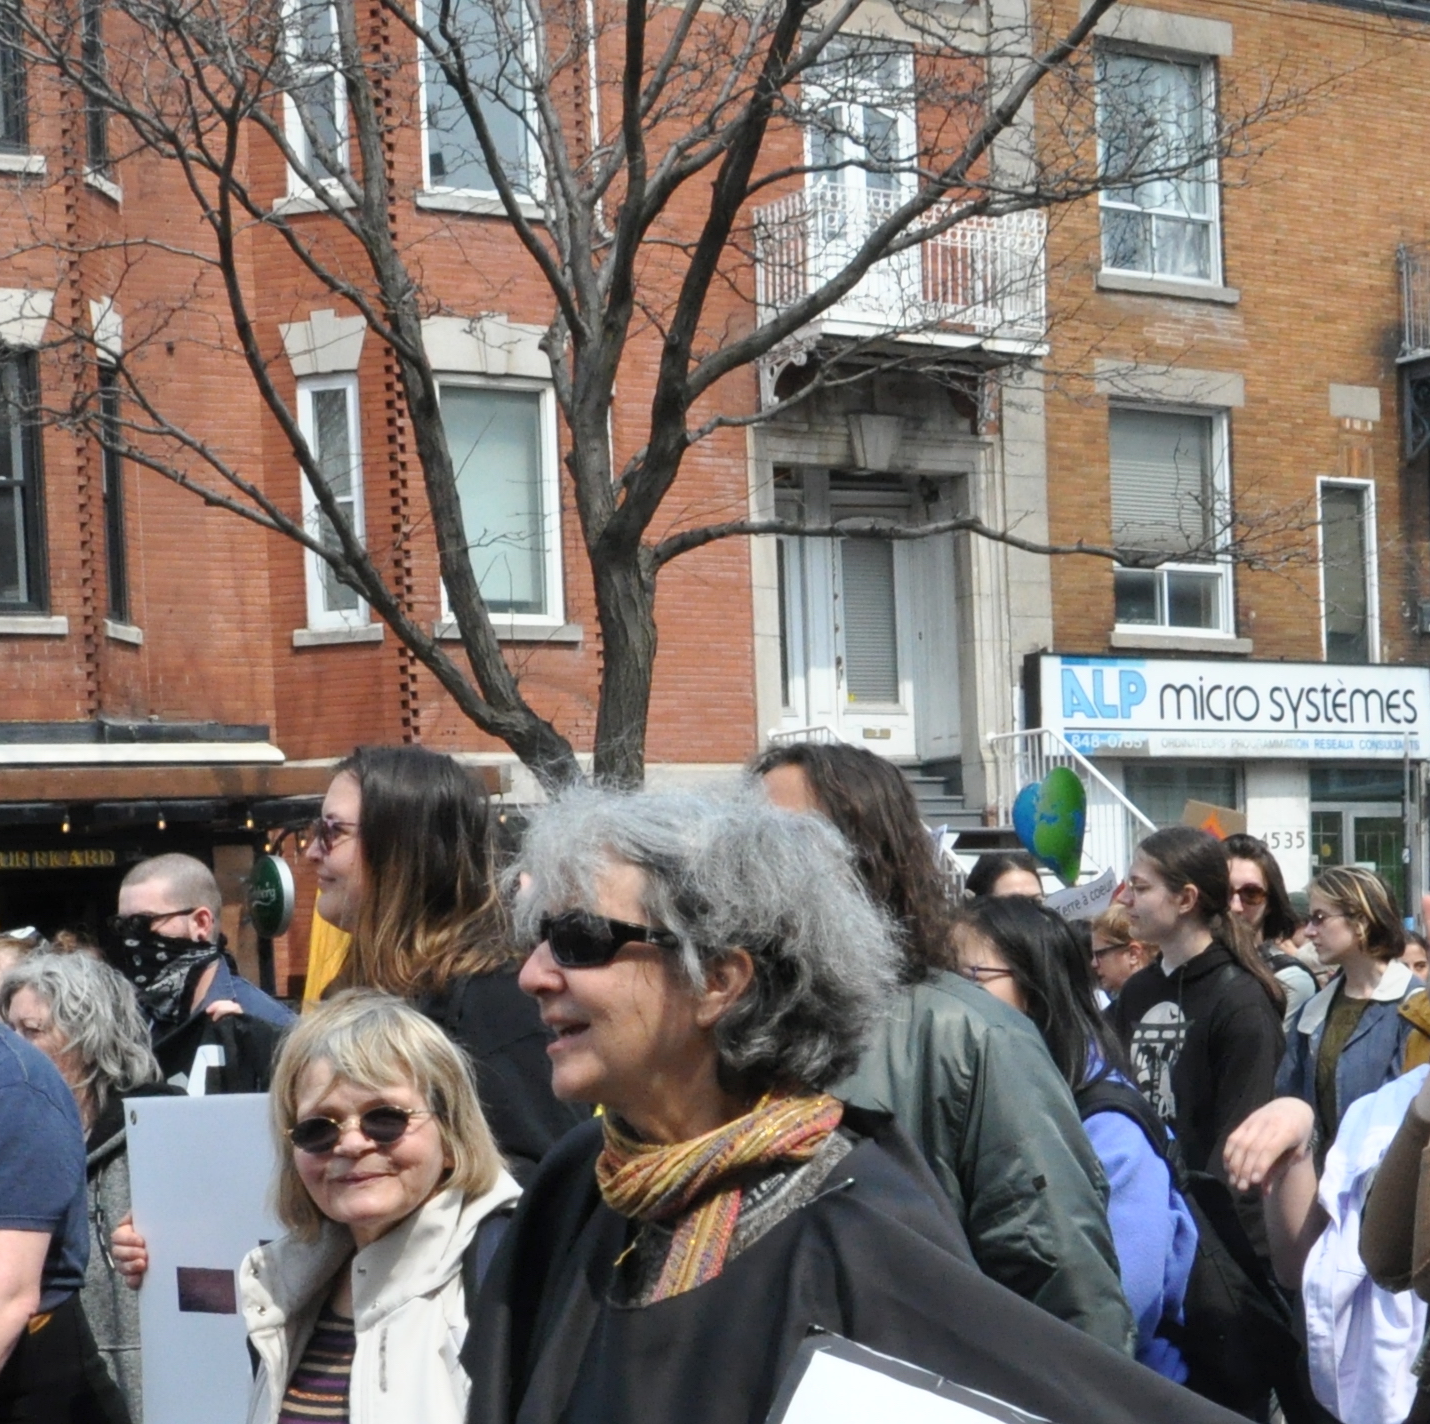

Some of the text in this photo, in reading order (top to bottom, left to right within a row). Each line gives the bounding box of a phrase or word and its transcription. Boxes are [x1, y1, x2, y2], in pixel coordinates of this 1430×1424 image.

[1061, 668, 1418, 728] ALP micro systèmes
[1161, 738, 1226, 750] ORDINATEURS
[1231, 738, 1309, 750] PROGRAMMATION
[1359, 739, 1420, 751] CONSULTATS
[1260, 831, 1305, 849] 4535
[32, 849, 115, 868] RICARD
